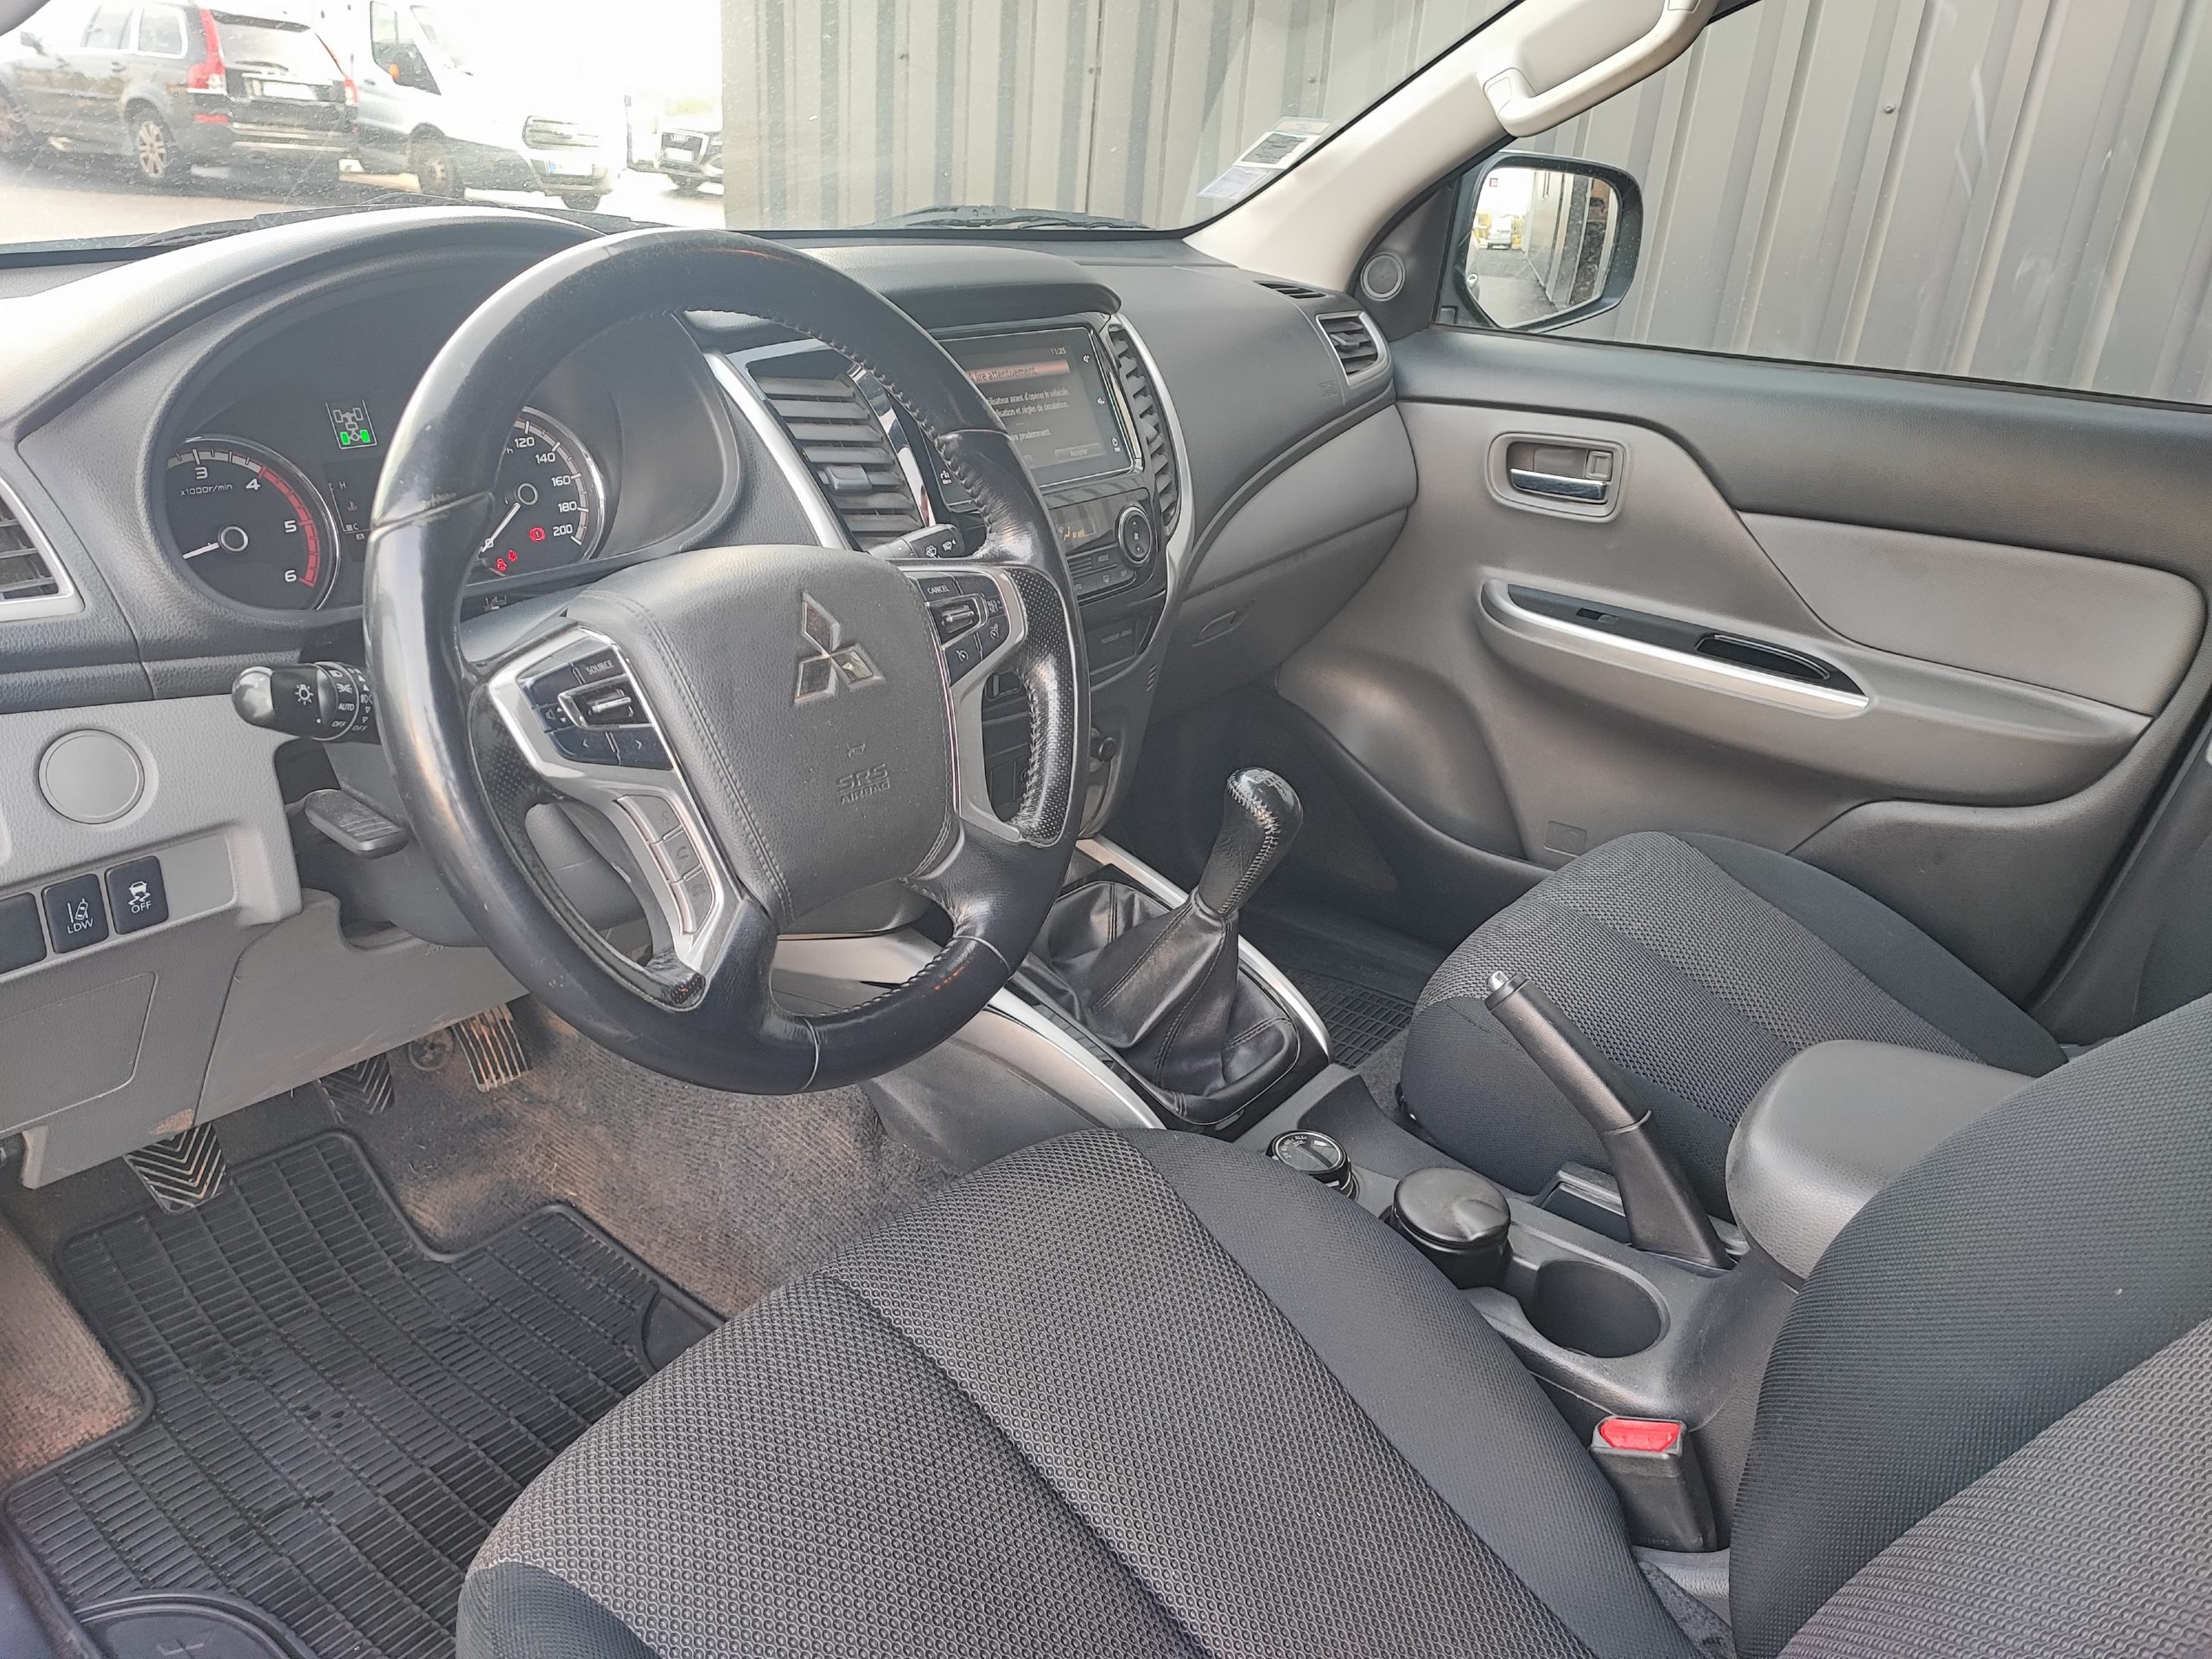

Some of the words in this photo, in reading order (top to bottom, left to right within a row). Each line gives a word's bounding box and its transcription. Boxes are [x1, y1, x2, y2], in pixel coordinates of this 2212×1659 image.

[988, 365, 1037, 380] attentivement
[514, 436, 535, 448] 120
[535, 452, 556, 464] 140
[194, 467, 208, 480] 3
[245, 478, 260, 491] 4
[551, 475, 571, 486] 160
[180, 483, 233, 497] x1000r/min
[557, 501, 577, 512] 180
[283, 520, 297, 533] 5
[553, 524, 573, 536] 200
[284, 569, 297, 582] 6
[926, 585, 950, 594] CANCEL
[586, 659, 614, 676] SOURCE
[338, 702, 354, 712] AUTO
[838, 763, 888, 793] SRS
[131, 900, 151, 913] OFF
[67, 918, 93, 934] LDW
